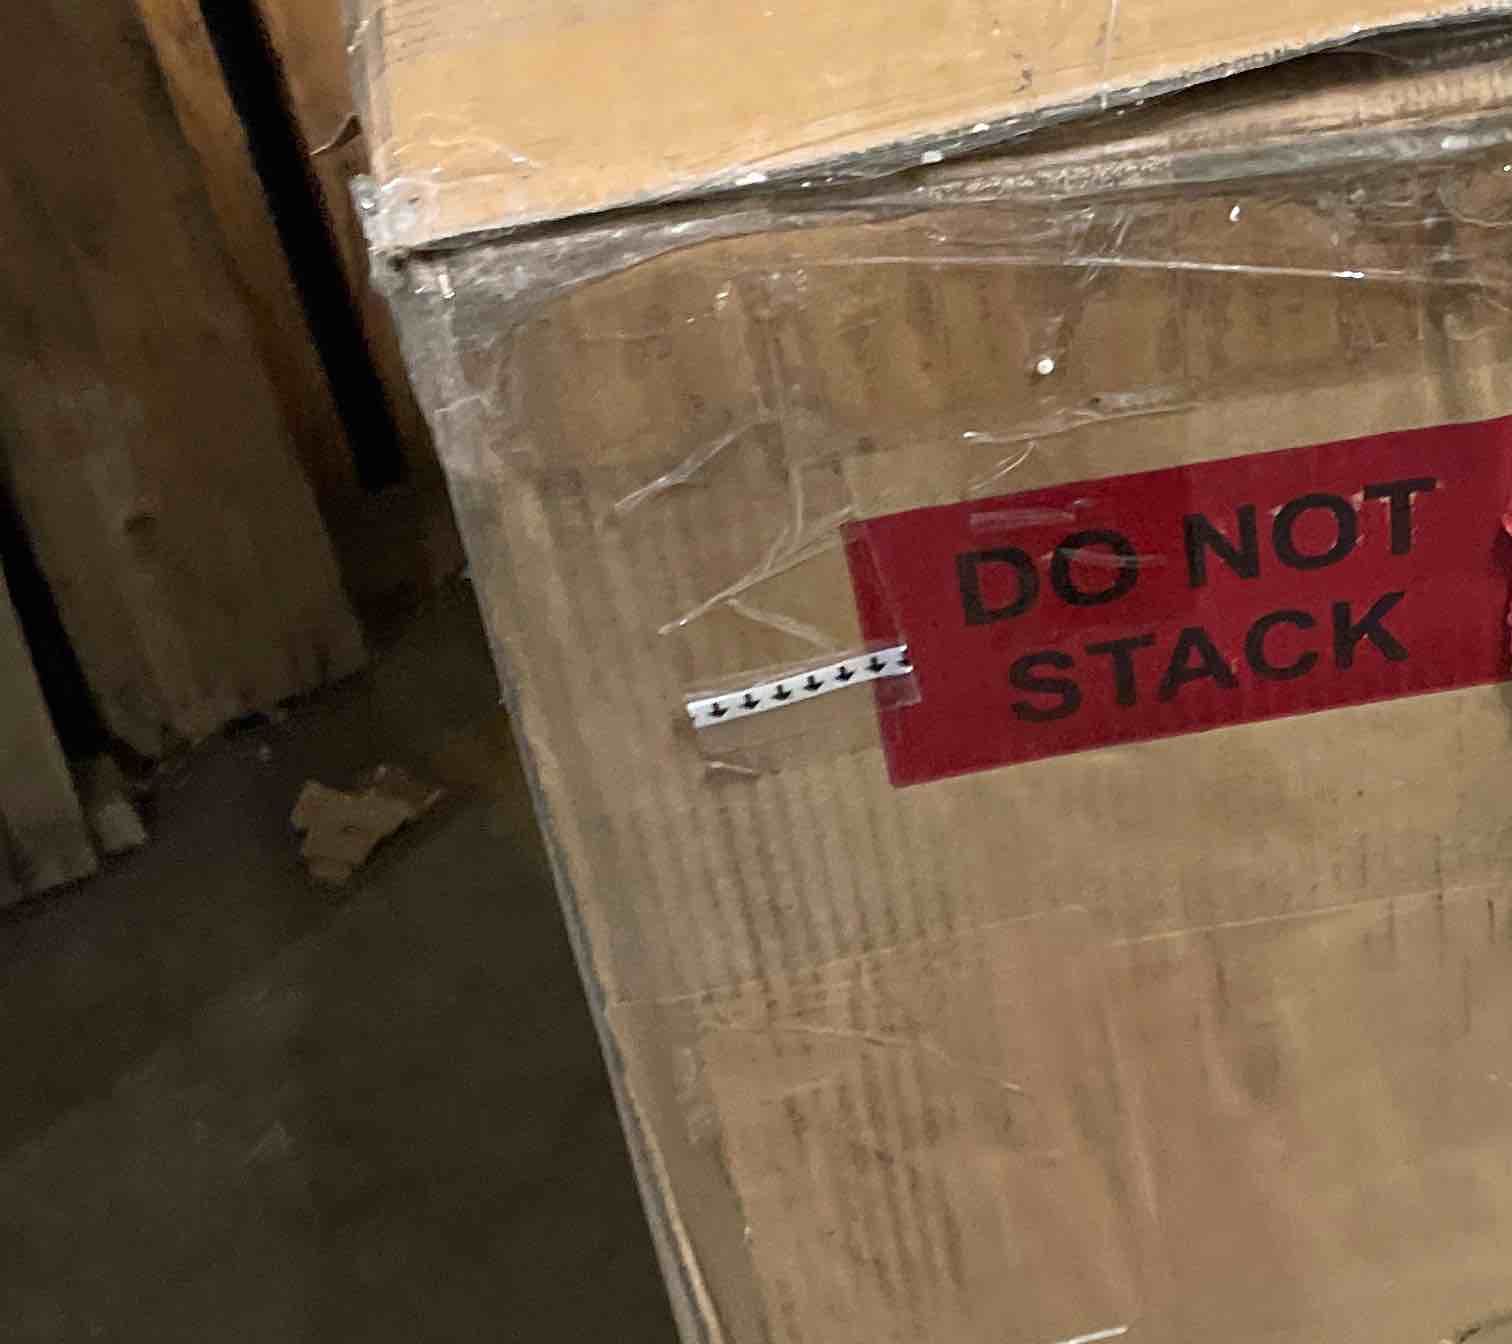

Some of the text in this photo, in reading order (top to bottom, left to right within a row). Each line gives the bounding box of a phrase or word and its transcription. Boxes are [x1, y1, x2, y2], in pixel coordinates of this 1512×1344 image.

[956, 477, 1438, 628] DO NOT
[1010, 592, 1410, 724] STACK
